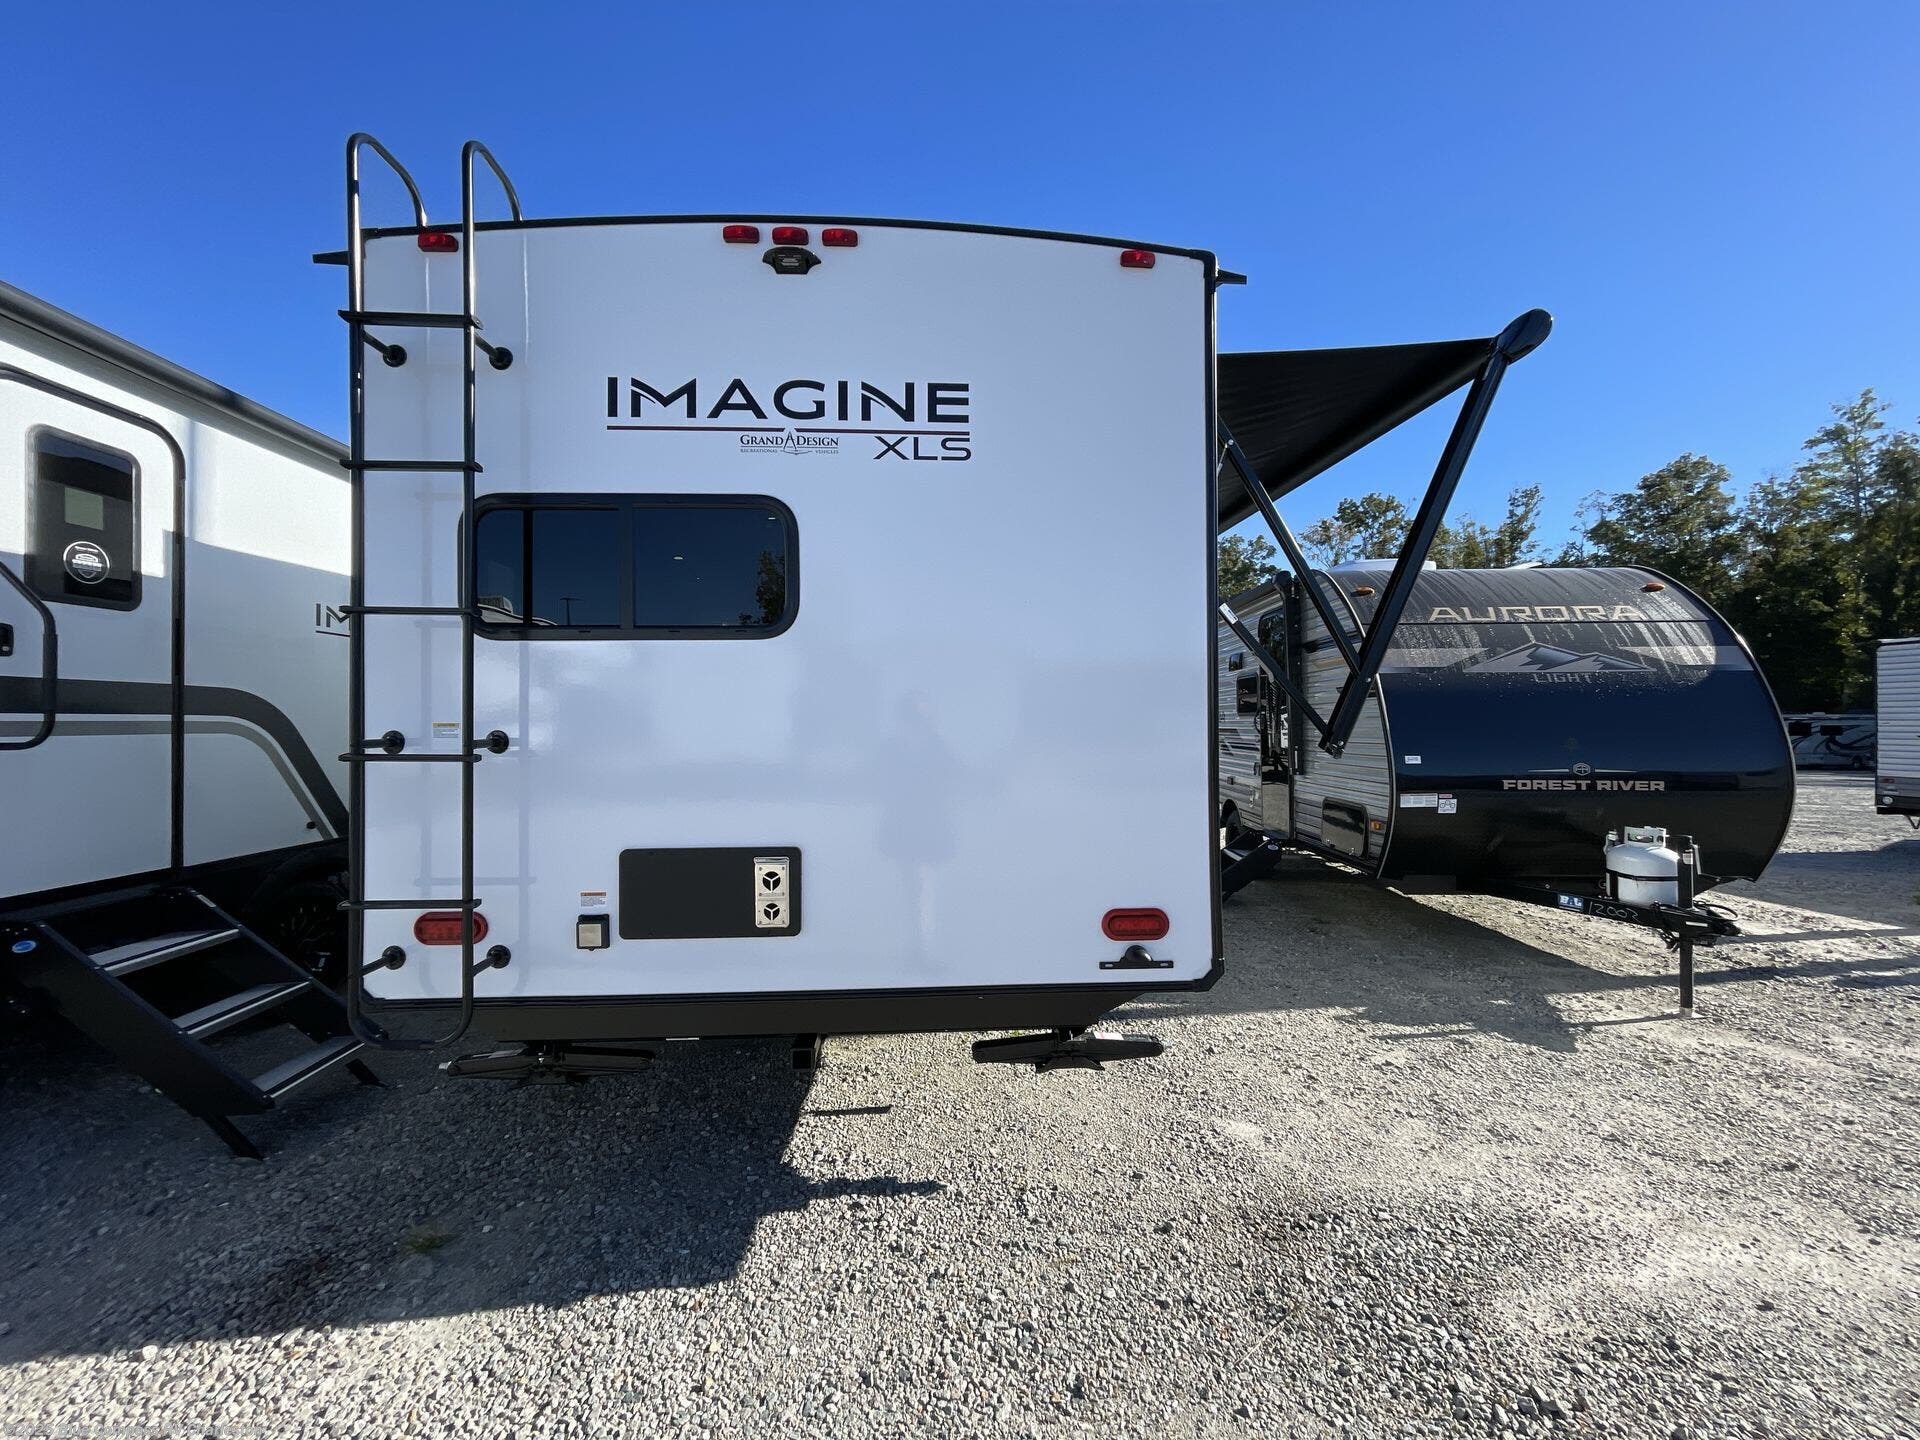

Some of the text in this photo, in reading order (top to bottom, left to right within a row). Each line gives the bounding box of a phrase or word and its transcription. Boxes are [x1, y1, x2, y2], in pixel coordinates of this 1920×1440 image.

[606, 376, 970, 424] IMAGINE
[740, 434, 839, 447] GRAND DESIGN
[873, 435, 972, 461] XLS
[1429, 605, 1645, 623] AURORA
[1532, 672, 1592, 684] LIGHT
[1502, 779, 1665, 791] FOREST RIVER
